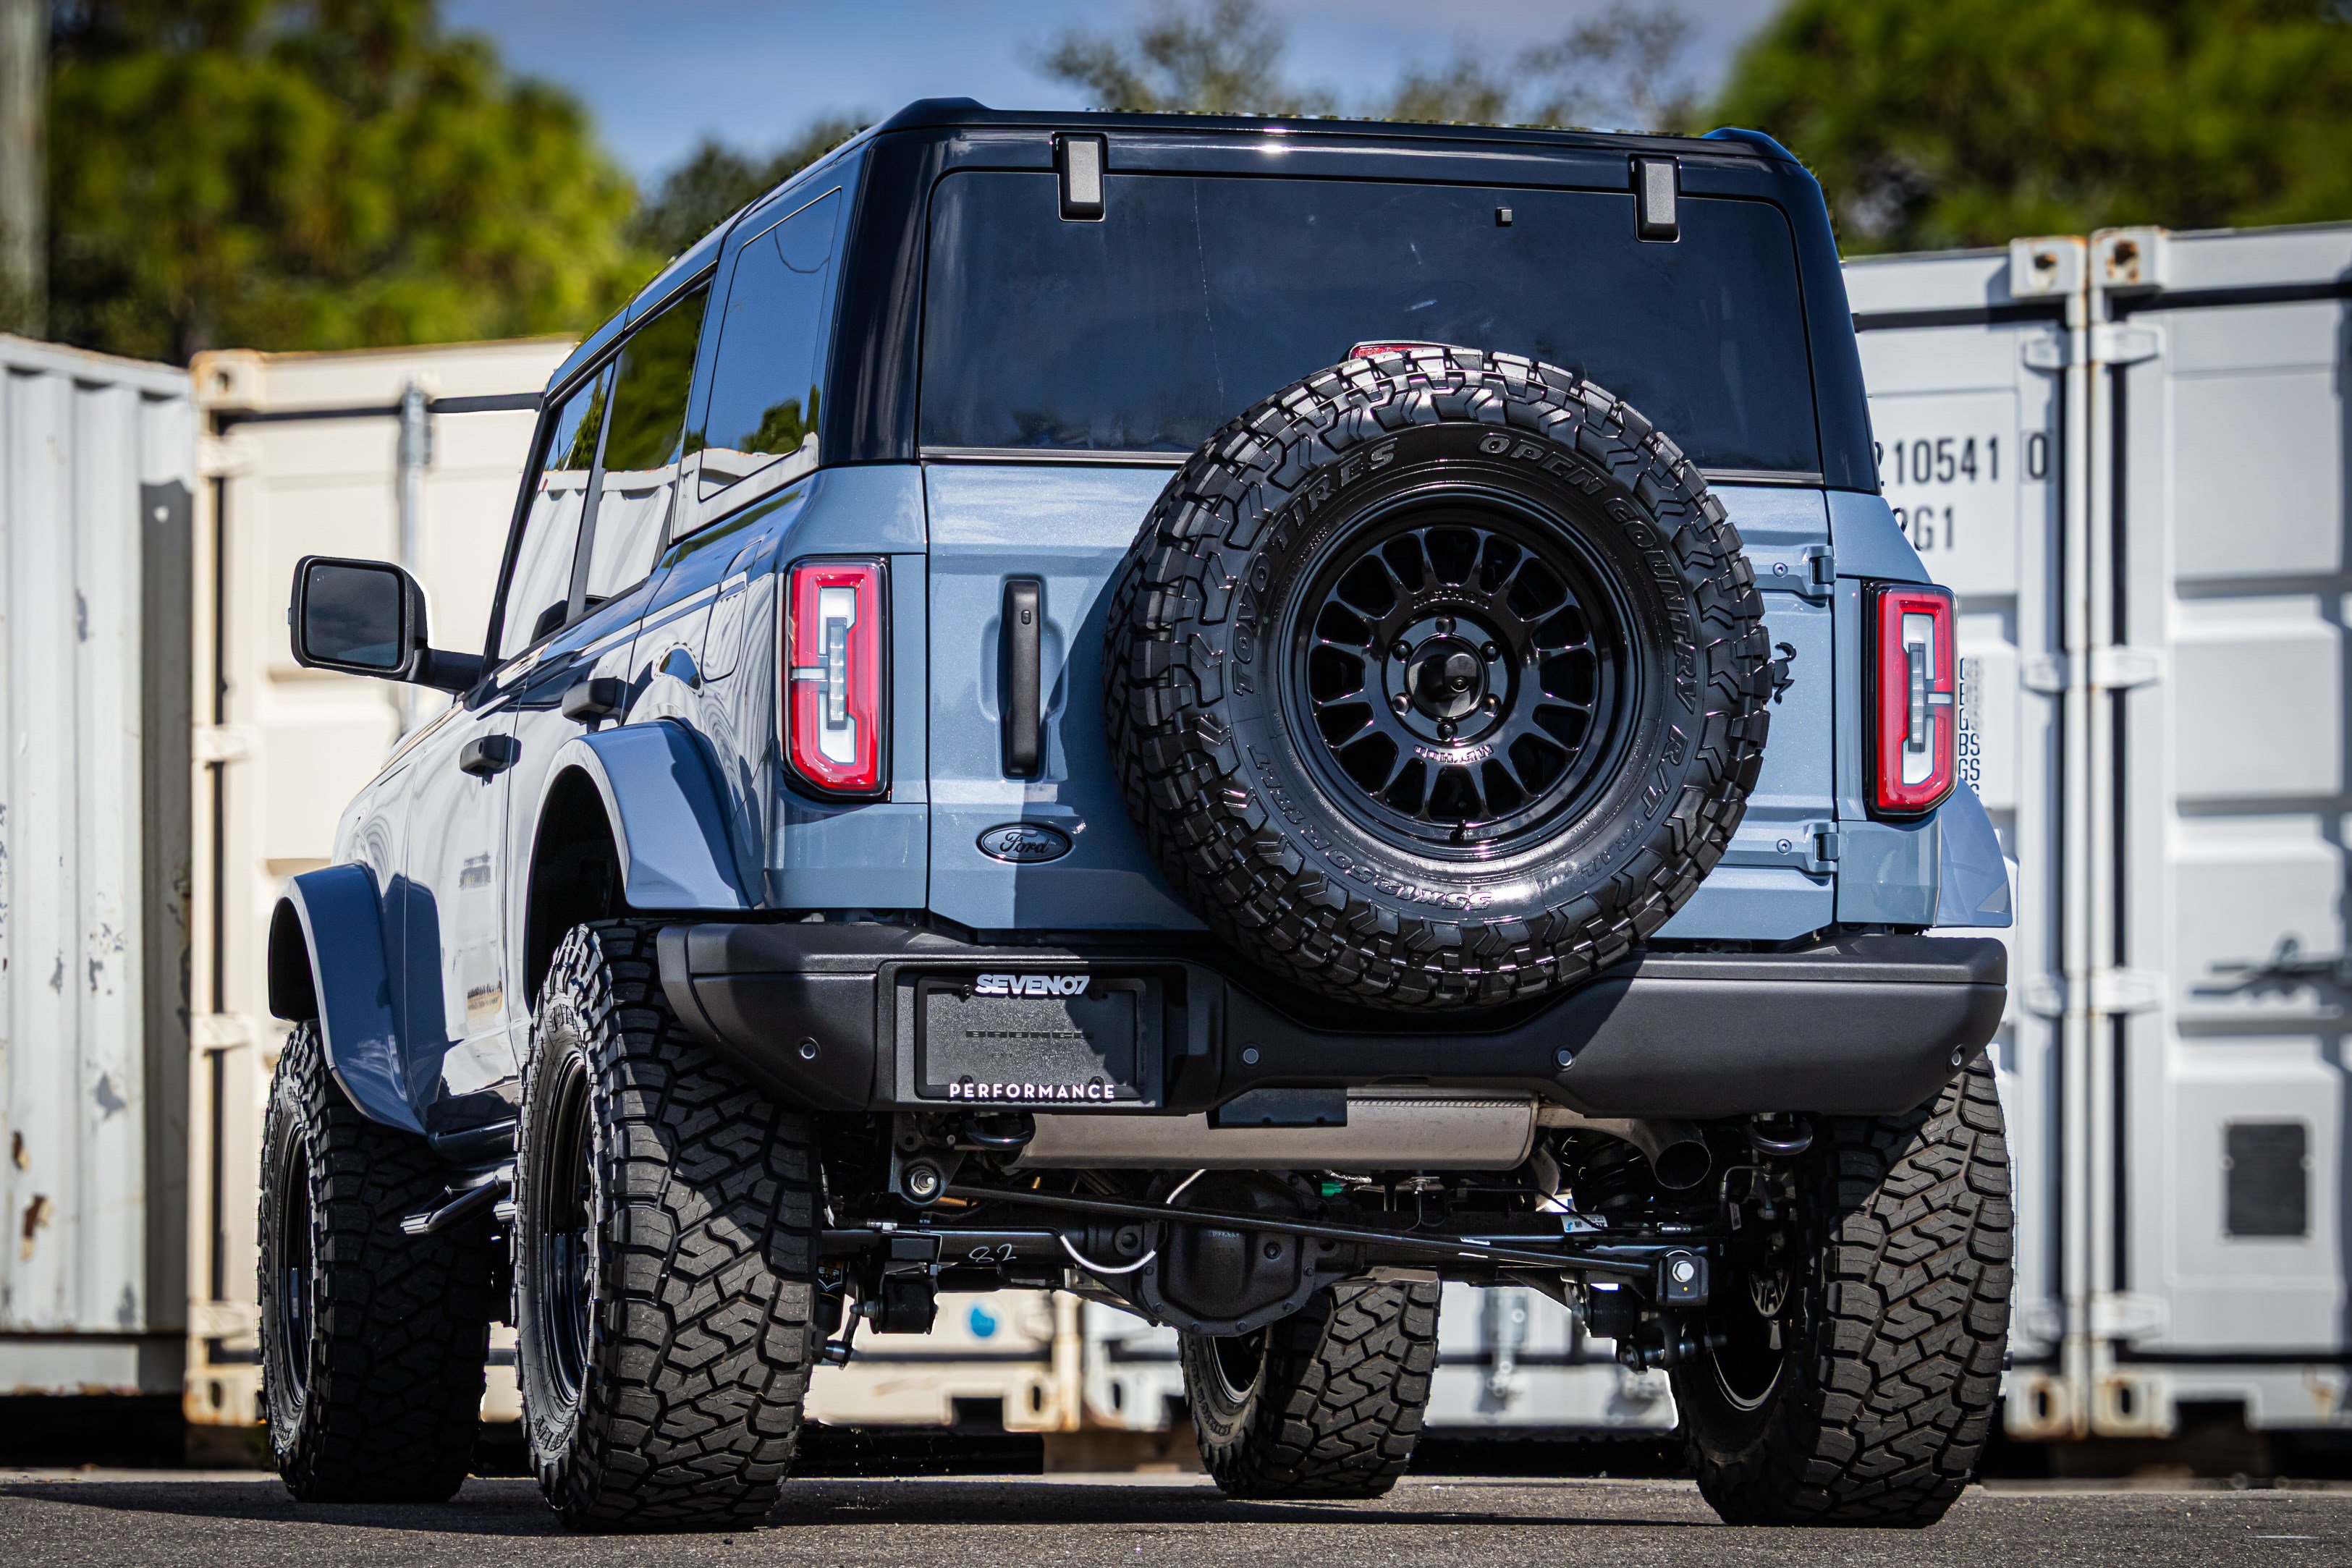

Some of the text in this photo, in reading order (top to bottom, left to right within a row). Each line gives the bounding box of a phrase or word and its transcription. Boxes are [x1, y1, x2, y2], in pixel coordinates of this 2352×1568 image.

[1231, 551, 1271, 696] TOYO
[1269, 437, 1398, 551] TIRES
[1477, 432, 1607, 496] OPEN
[1603, 497, 1697, 714] COUNTRY
[999, 832, 1049, 855] Ford
[949, 1083, 1115, 1100] PERFORMANCE
